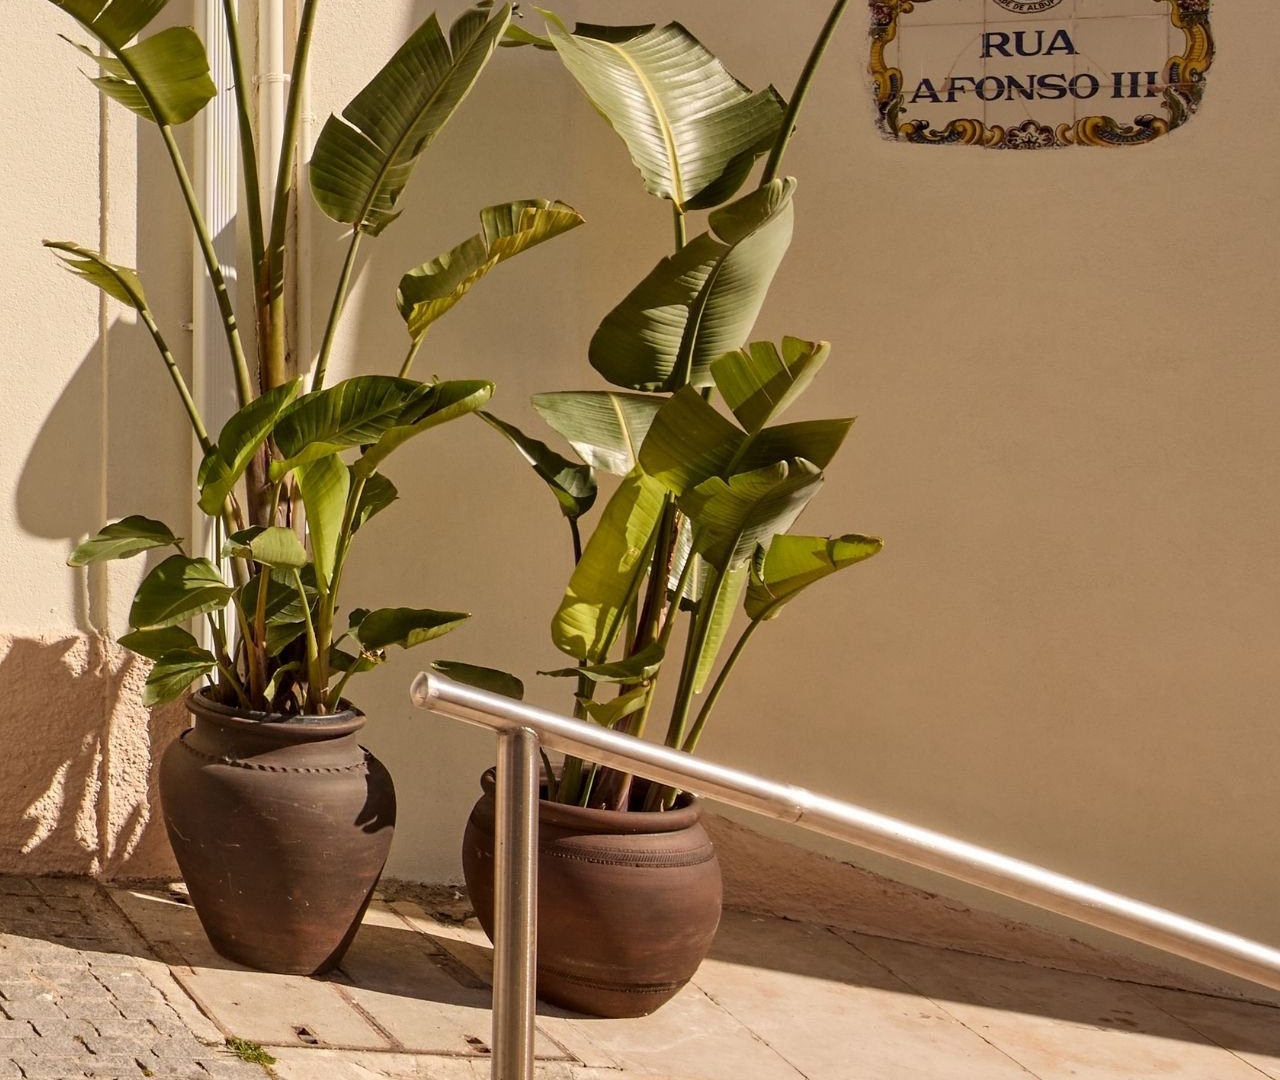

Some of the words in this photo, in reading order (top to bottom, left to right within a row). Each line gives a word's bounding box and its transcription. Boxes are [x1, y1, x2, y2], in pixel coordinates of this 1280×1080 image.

[1012, 3, 1024, 11] DE
[979, 29, 1080, 58] RUA
[908, 73, 1100, 104] AFONSO
[1110, 71, 1159, 98] III
